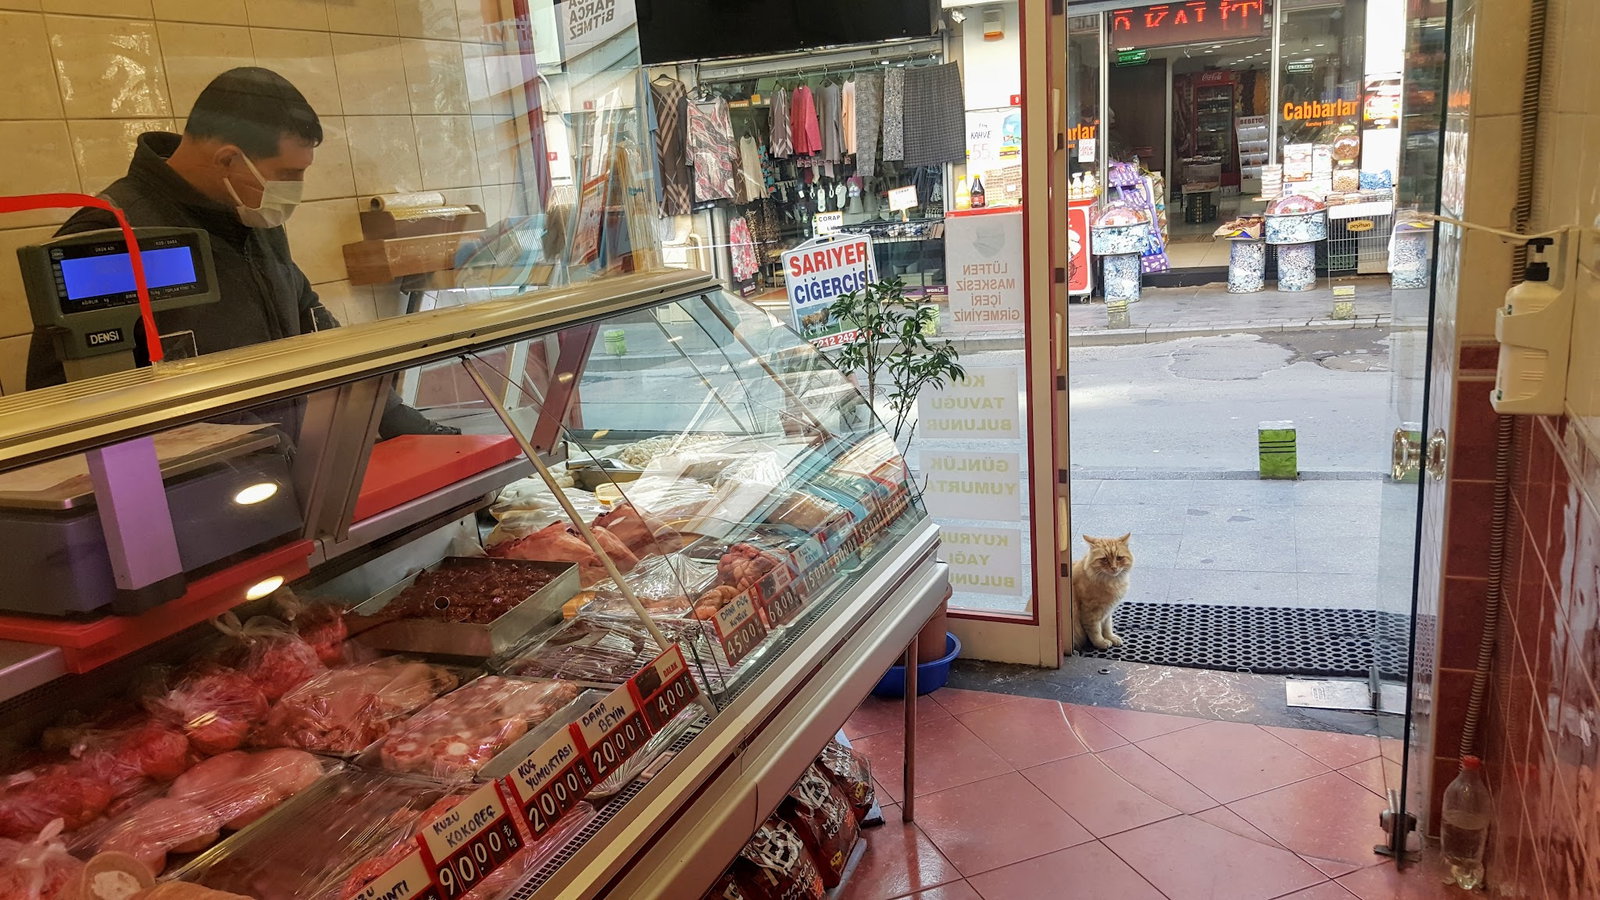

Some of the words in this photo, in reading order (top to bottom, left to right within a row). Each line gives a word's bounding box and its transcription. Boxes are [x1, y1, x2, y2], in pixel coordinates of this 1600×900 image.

[1283, 98, 1359, 121] Cabbarlar
[789, 241, 870, 278] SARIYER
[582, 702, 608, 728] DANA
[433, 811, 461, 836] KUZU
